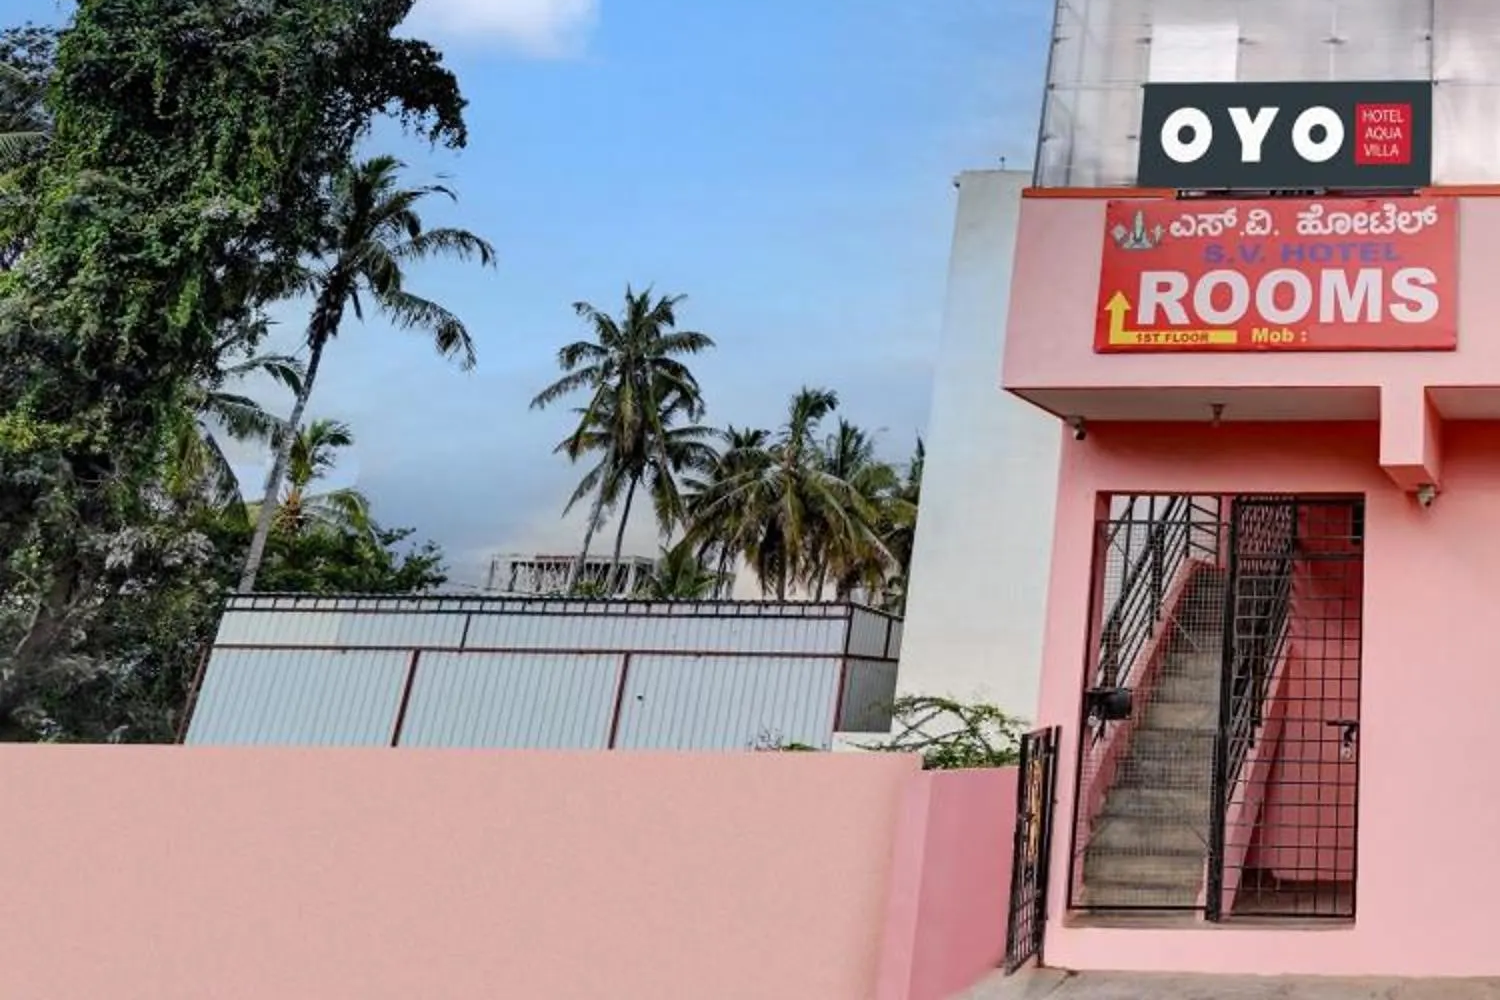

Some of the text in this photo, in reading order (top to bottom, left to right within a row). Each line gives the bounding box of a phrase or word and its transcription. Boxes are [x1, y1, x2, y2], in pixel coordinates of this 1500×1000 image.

[1363, 109, 1405, 123] HOTEL
[1160, 106, 1345, 163] OYO
[1365, 126, 1403, 140] AQUA
[1363, 143, 1400, 157] VILLA
[1296, 203, 1439, 236] ಹೋಟೆಲ್
[1280, 242, 1402, 264] HOTEL
[1137, 267, 1439, 325] ROOMS
